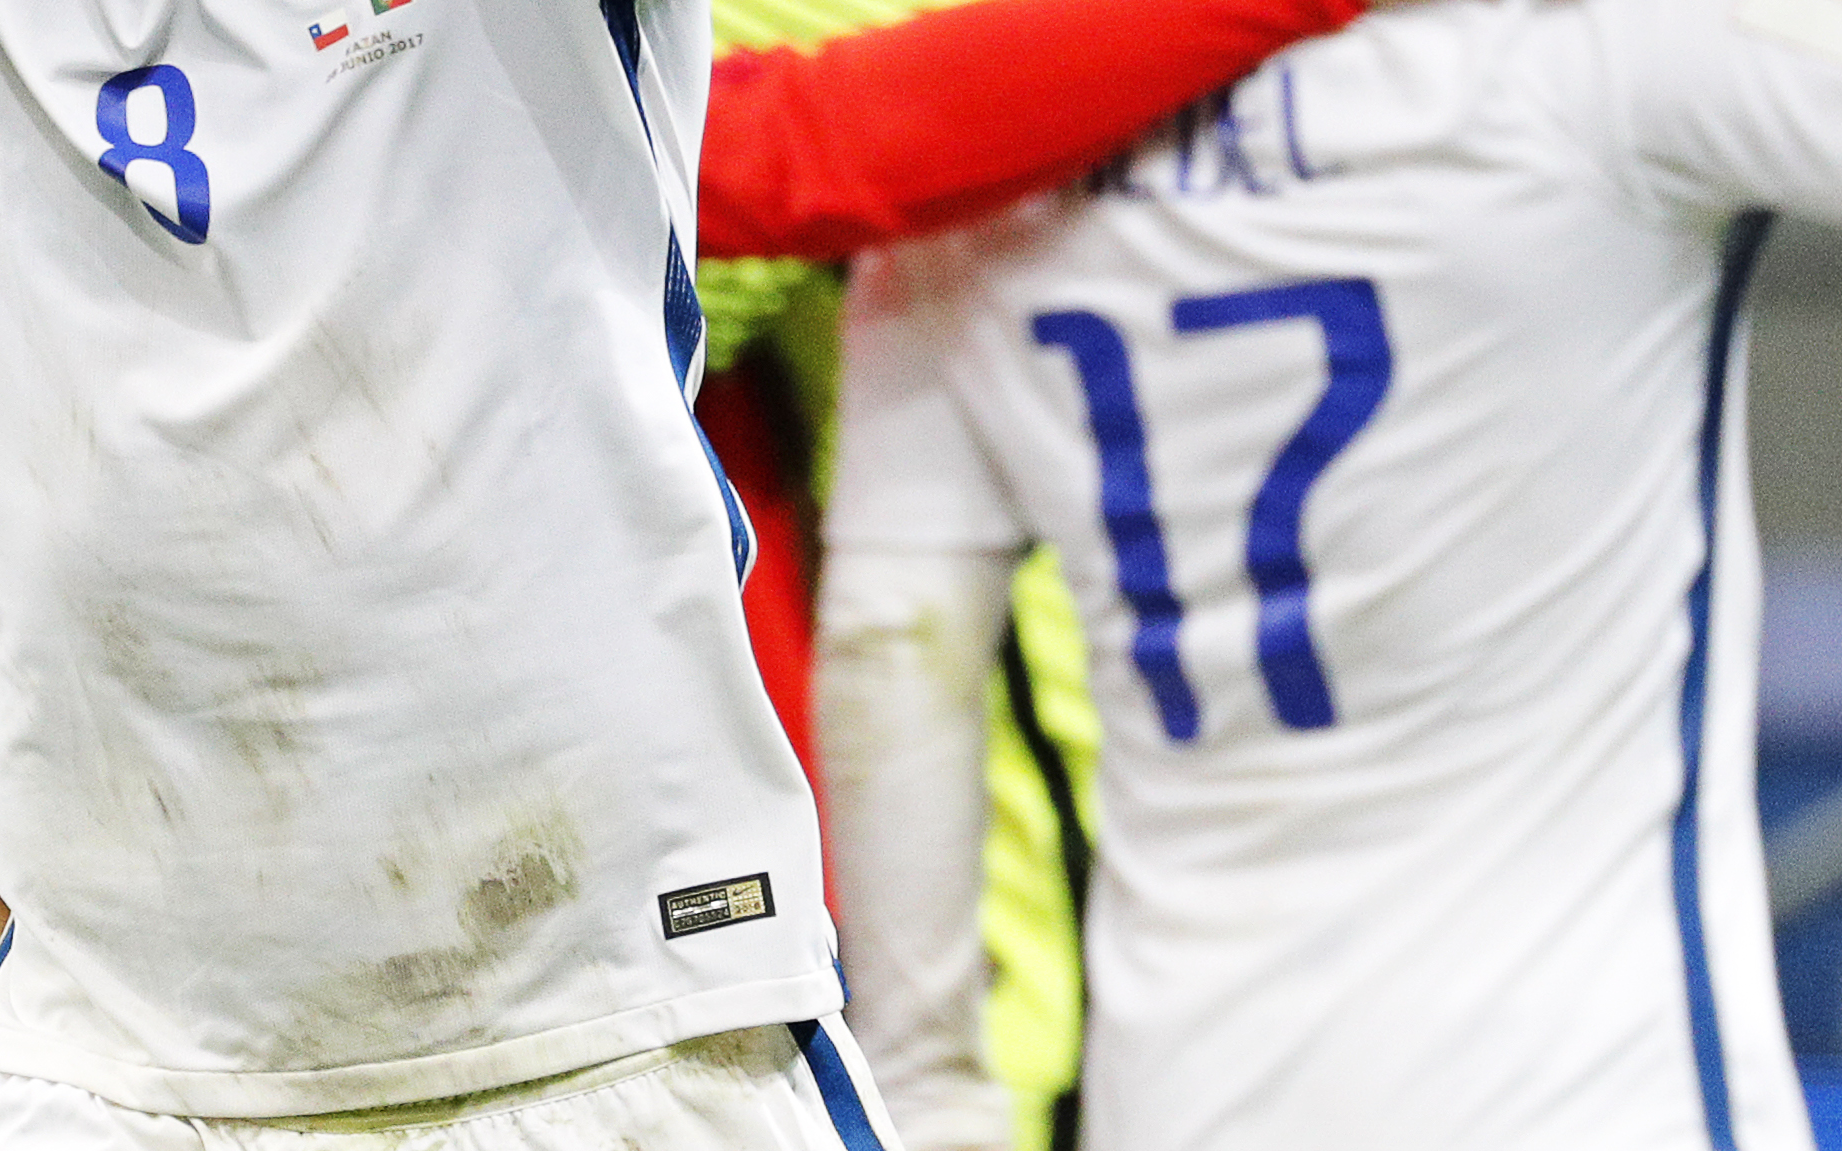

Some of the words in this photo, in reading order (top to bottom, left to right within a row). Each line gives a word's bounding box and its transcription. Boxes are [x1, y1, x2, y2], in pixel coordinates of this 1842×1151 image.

[389, 33, 424, 55] 2017
[96, 64, 211, 245] 8
[1030, 277, 1395, 745] 17
[671, 890, 726, 909] AUTHENTIC
